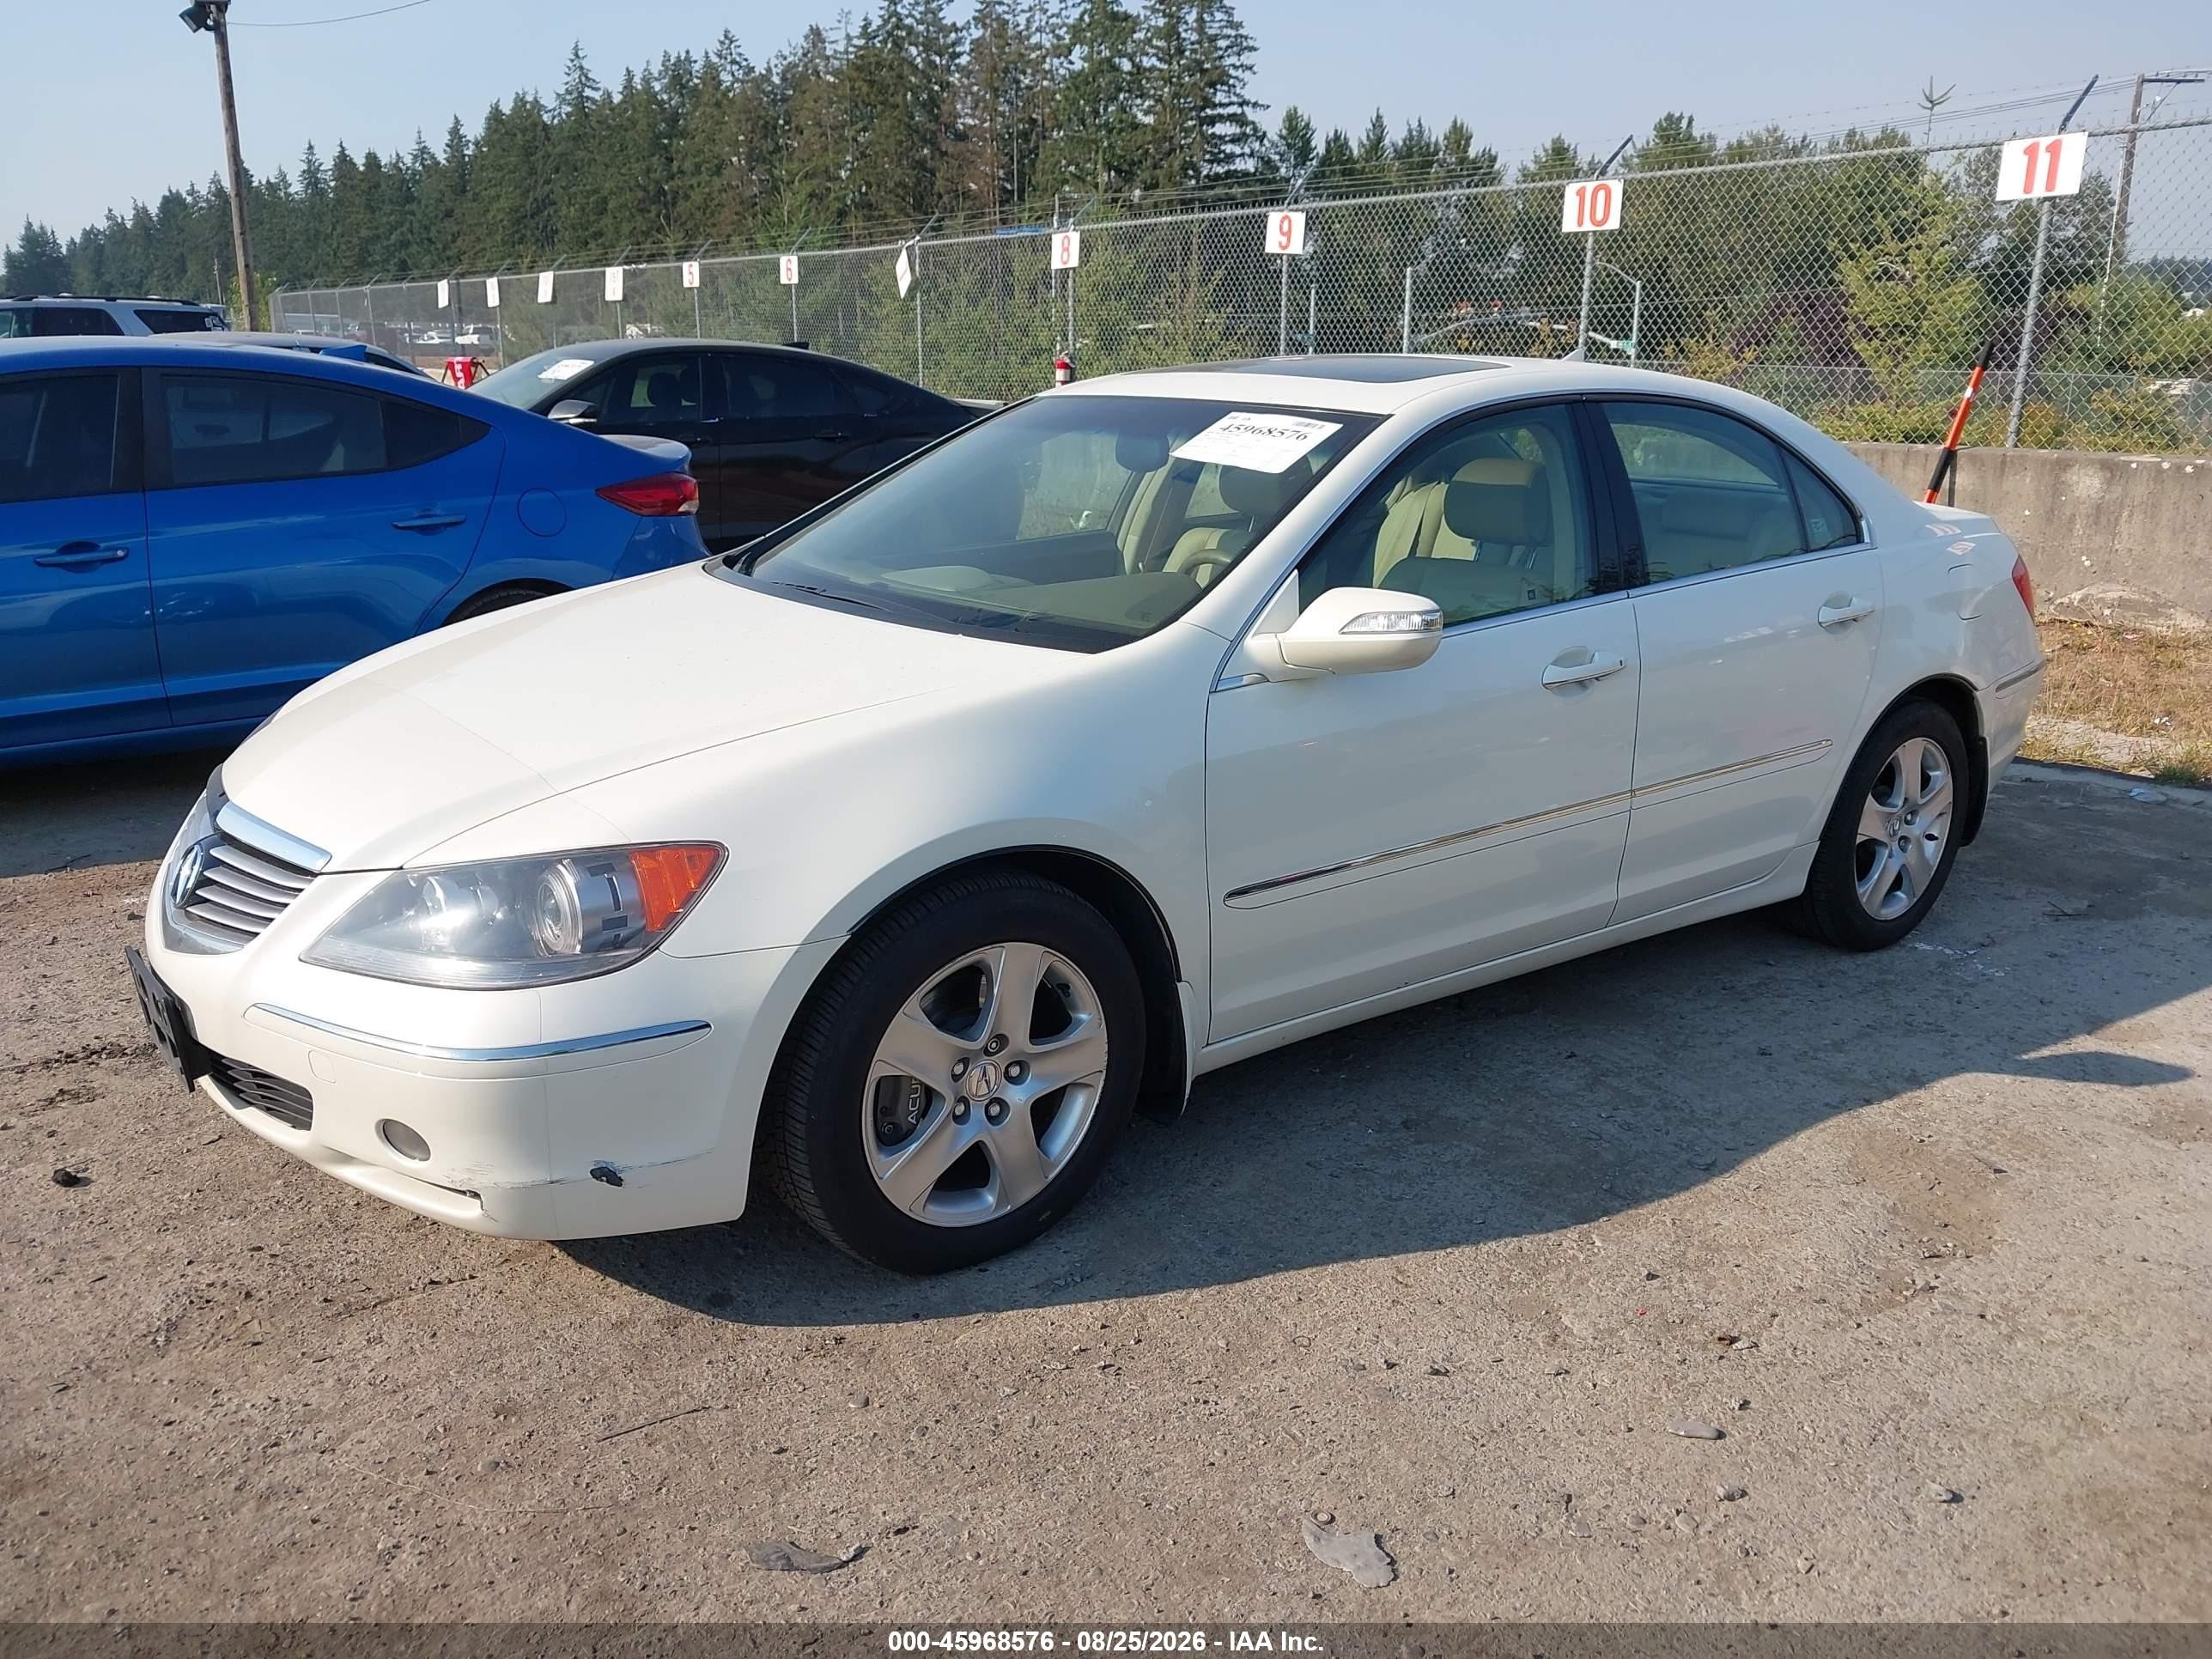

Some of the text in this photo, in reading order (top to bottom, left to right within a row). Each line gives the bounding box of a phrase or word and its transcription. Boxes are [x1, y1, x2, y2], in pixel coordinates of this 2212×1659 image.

[2022, 138, 2063, 194] 11
[1575, 182, 1613, 228] 10
[1278, 214, 1293, 252] 9
[1060, 234, 1071, 266] 8
[687, 263, 696, 286] 5
[786, 260, 794, 283] 6
[1218, 422, 1310, 441] 45968576
